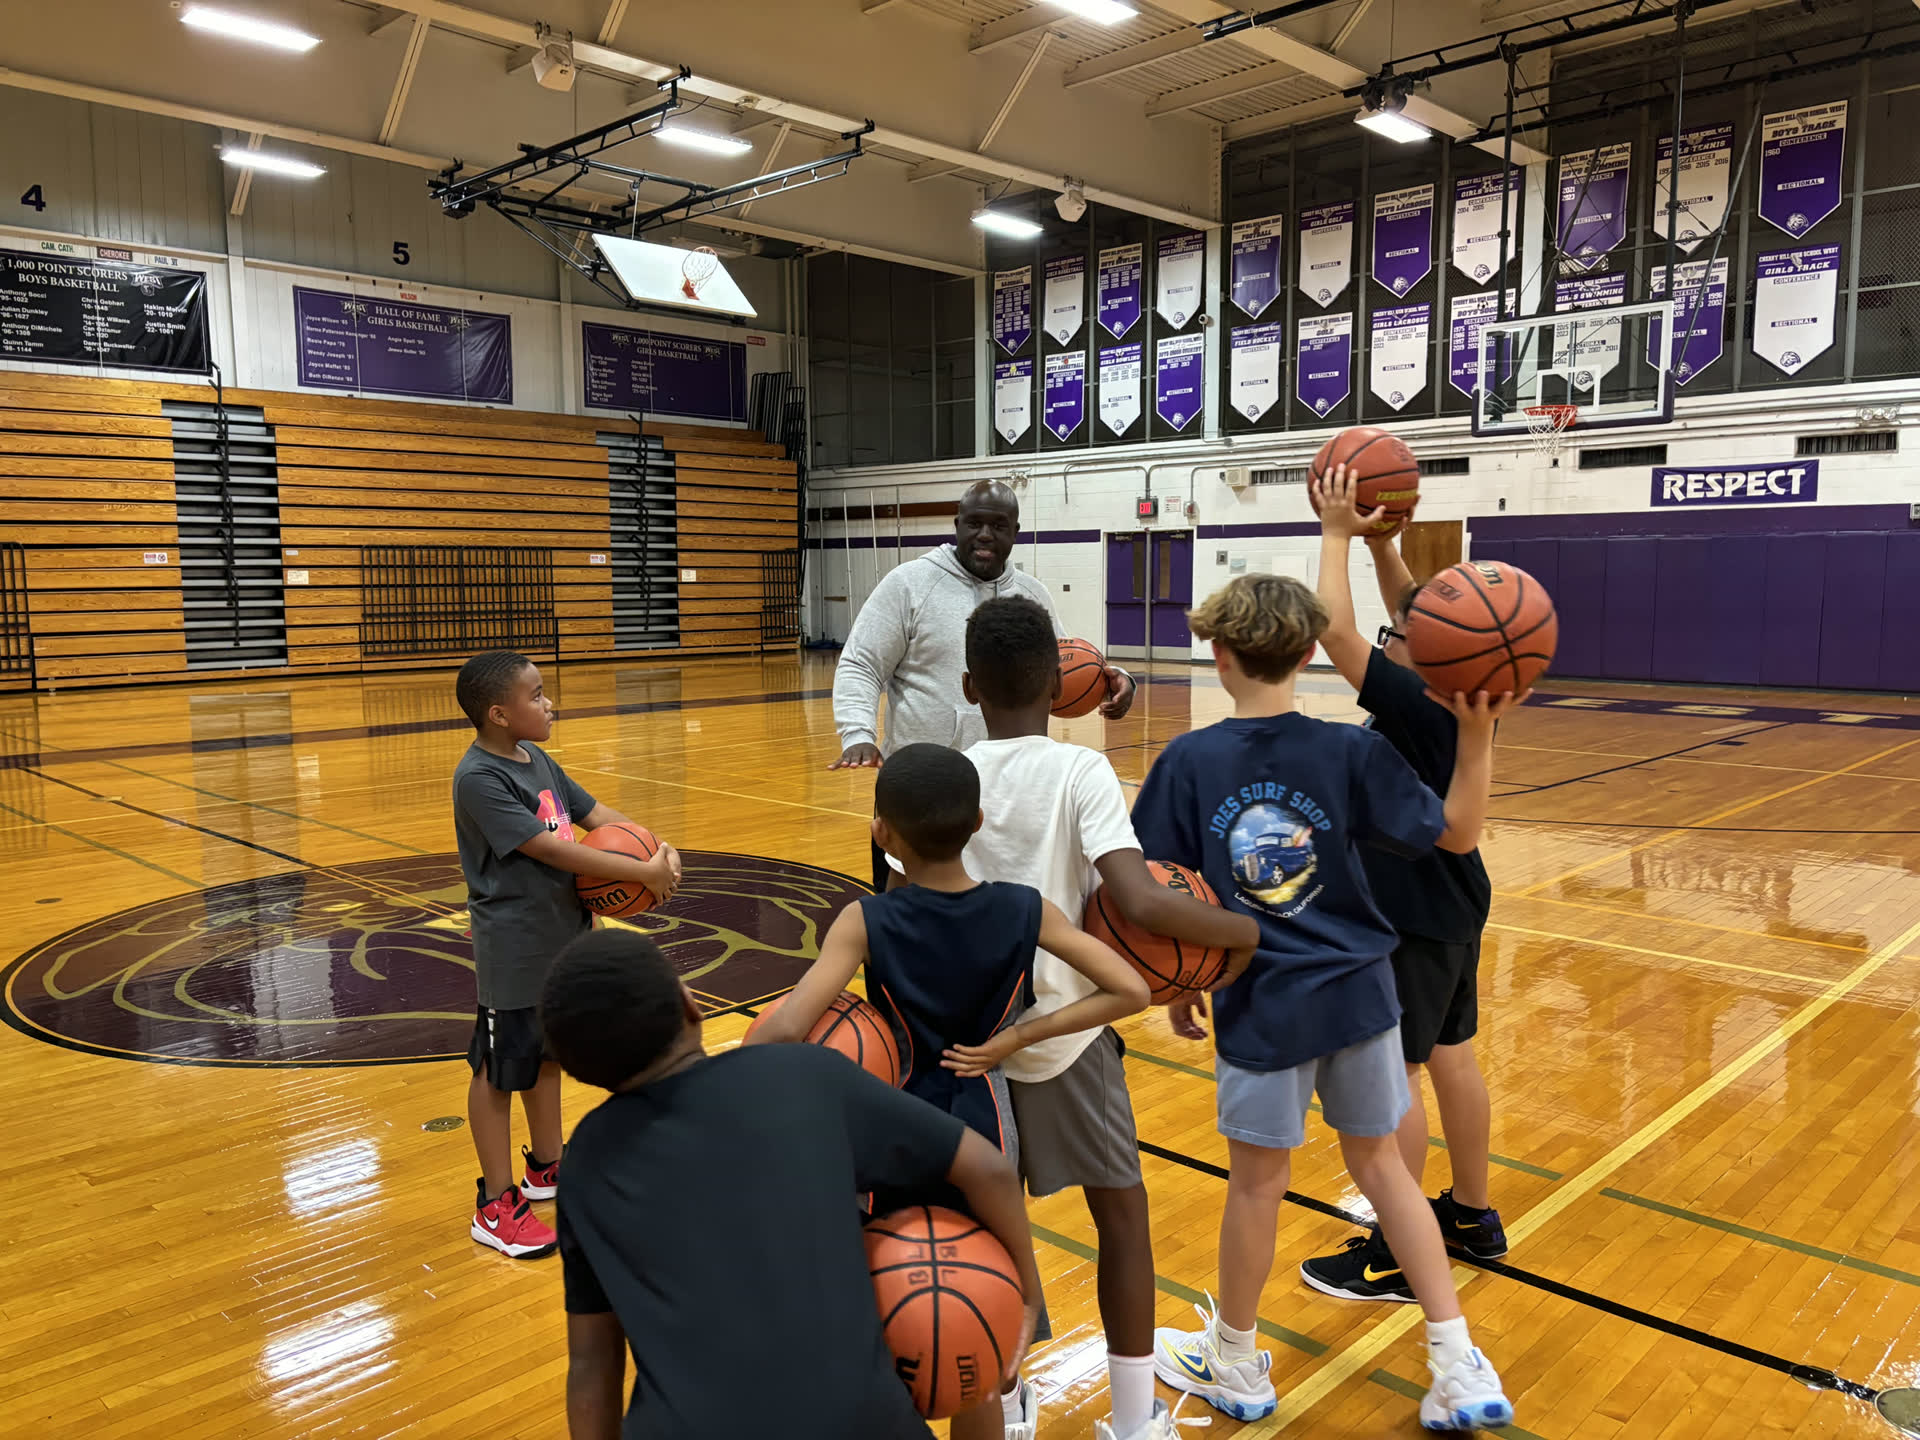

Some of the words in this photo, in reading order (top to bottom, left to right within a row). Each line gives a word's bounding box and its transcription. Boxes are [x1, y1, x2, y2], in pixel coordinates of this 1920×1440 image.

[1829, 104, 1846, 112] WEST
[1772, 127, 1799, 138] BOYS
[1802, 120, 1837, 133] TRACK
[1691, 140, 1726, 151] TENNIS
[1781, 134, 1825, 146] CONFERENCE
[1782, 179, 1820, 190] SECTIONAL
[20, 184, 46, 212] 4
[1461, 188, 1483, 198] GIRLS
[1396, 199, 1432, 210] LACROSSE
[40, 242, 56, 250] CAM.
[58, 244, 75, 253] CATH.
[99, 249, 130, 260] CHEROKEE
[392, 242, 410, 265] 5
[154, 256, 168, 265] PAUL
[7, 258, 35, 271] 1,000
[38, 262, 75, 274] POINT
[76, 266, 128, 280] SCORERS
[1765, 266, 1794, 275] GIRLS
[1797, 261, 1830, 272] TRACK
[18, 273, 48, 285] BOYS
[50, 278, 120, 293] BASKETBALL
[1775, 274, 1818, 284] CONFERENCE
[1580, 288, 1623, 299] SWIMMING
[375, 306, 400, 317] HALL
[401, 310, 415, 318] OF
[416, 312, 441, 322] FAME
[1458, 309, 1478, 317] BOYS
[167, 322, 186, 330] Smith
[367, 316, 394, 326] GIRLS
[395, 320, 449, 334] BASKETBALL
[1393, 316, 1429, 326] LACROSSE
[1775, 318, 1814, 327] SECTIONAL
[650, 338, 671, 348] POINT
[673, 342, 702, 352] SCORERS
[636, 347, 657, 356] GIRLS
[658, 350, 699, 361] BASKETBALL
[1662, 468, 1806, 502] RESPECT
[1208, 796, 1242, 839] JOES
[1240, 782, 1288, 804] SURF
[1288, 792, 1332, 832] SHOP
[1293, 884, 1325, 914] CALIFORNIA
